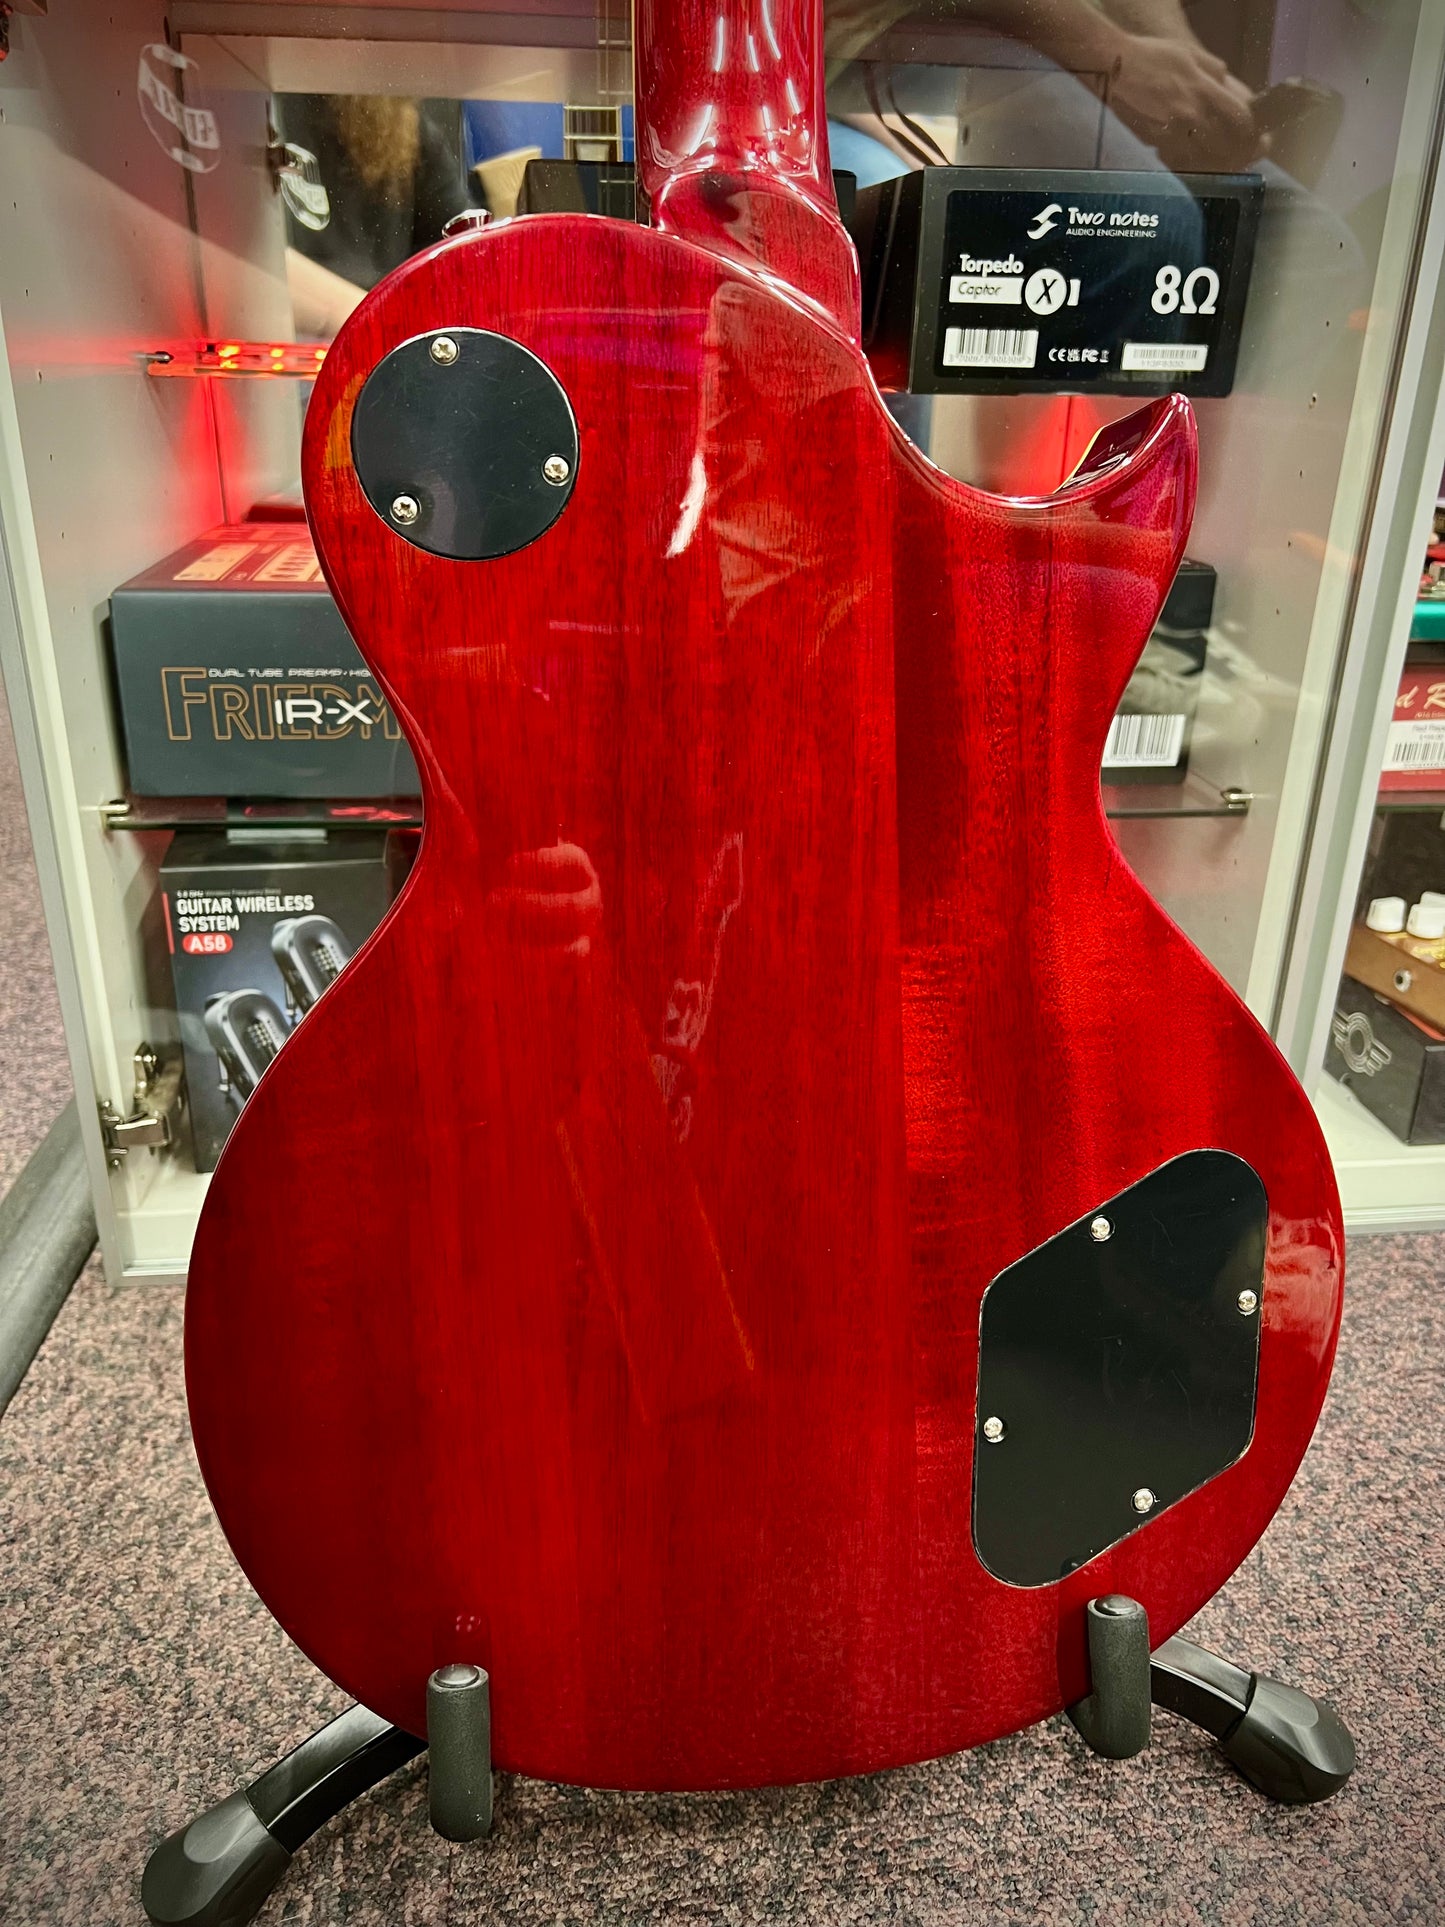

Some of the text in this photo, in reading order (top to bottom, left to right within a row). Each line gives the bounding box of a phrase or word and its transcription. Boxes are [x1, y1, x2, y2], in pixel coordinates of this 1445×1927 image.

[1068, 206, 1160, 228] Two notes
[1065, 228, 1157, 239] AUDIO ENGINEERING
[959, 253, 1024, 277] Torpedo
[958, 278, 1058, 304] Captor X
[208, 668, 245, 678] DUAL
[248, 668, 284, 678] TUBE
[274, 699, 374, 725] IR-X
[176, 895, 315, 915] GUITAR WIRELESS
[178, 915, 240, 932] SYSTEM
[190, 934, 227, 952] A58
